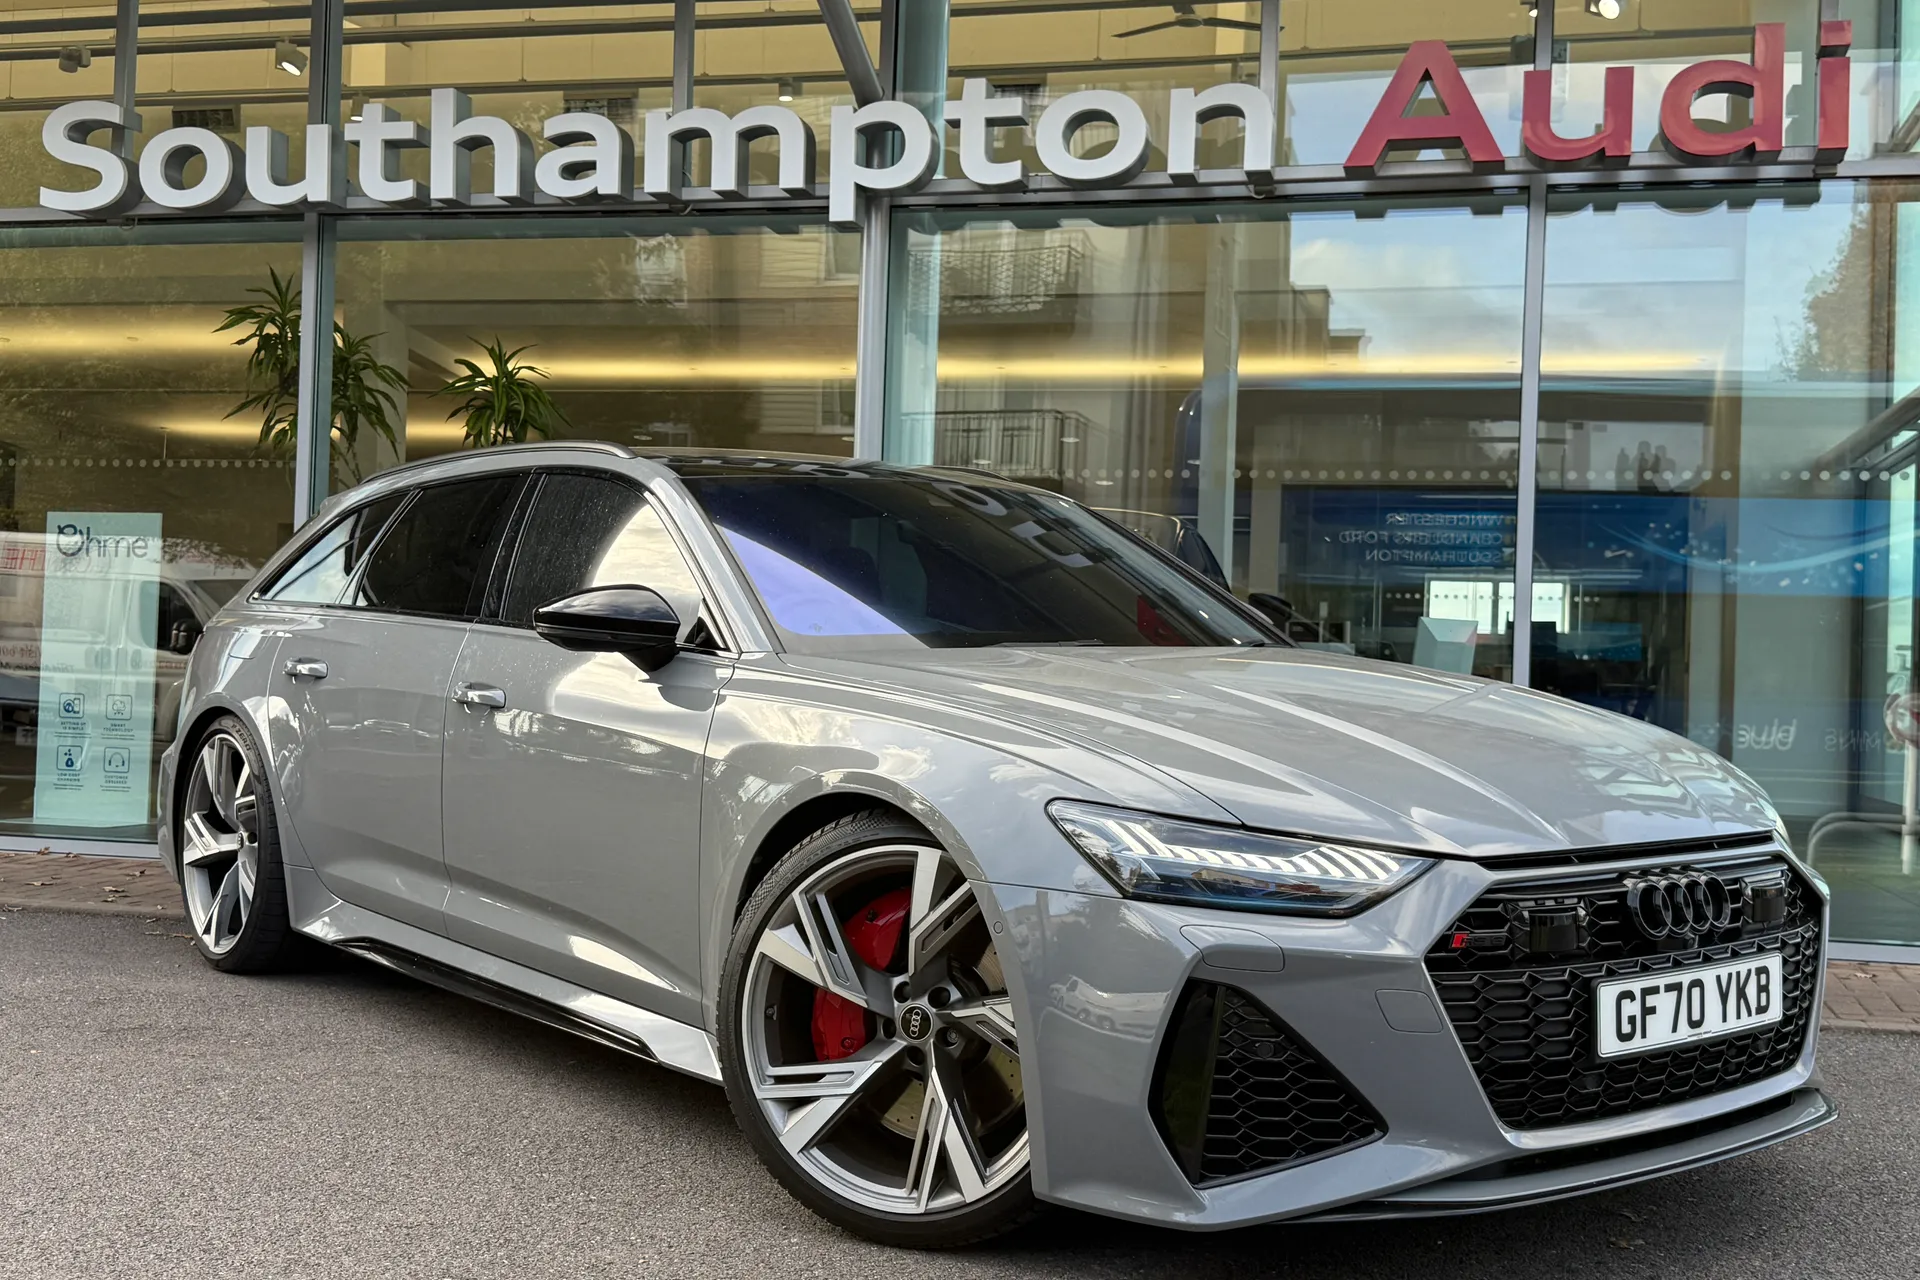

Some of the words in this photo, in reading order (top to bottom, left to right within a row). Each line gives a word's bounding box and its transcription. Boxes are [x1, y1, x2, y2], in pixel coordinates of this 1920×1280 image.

[40, 78, 1274, 224] Southampton
[1344, 20, 1852, 174] Audi
[1615, 978, 1705, 1043] GF70
[1715, 965, 1771, 1024] YKB
